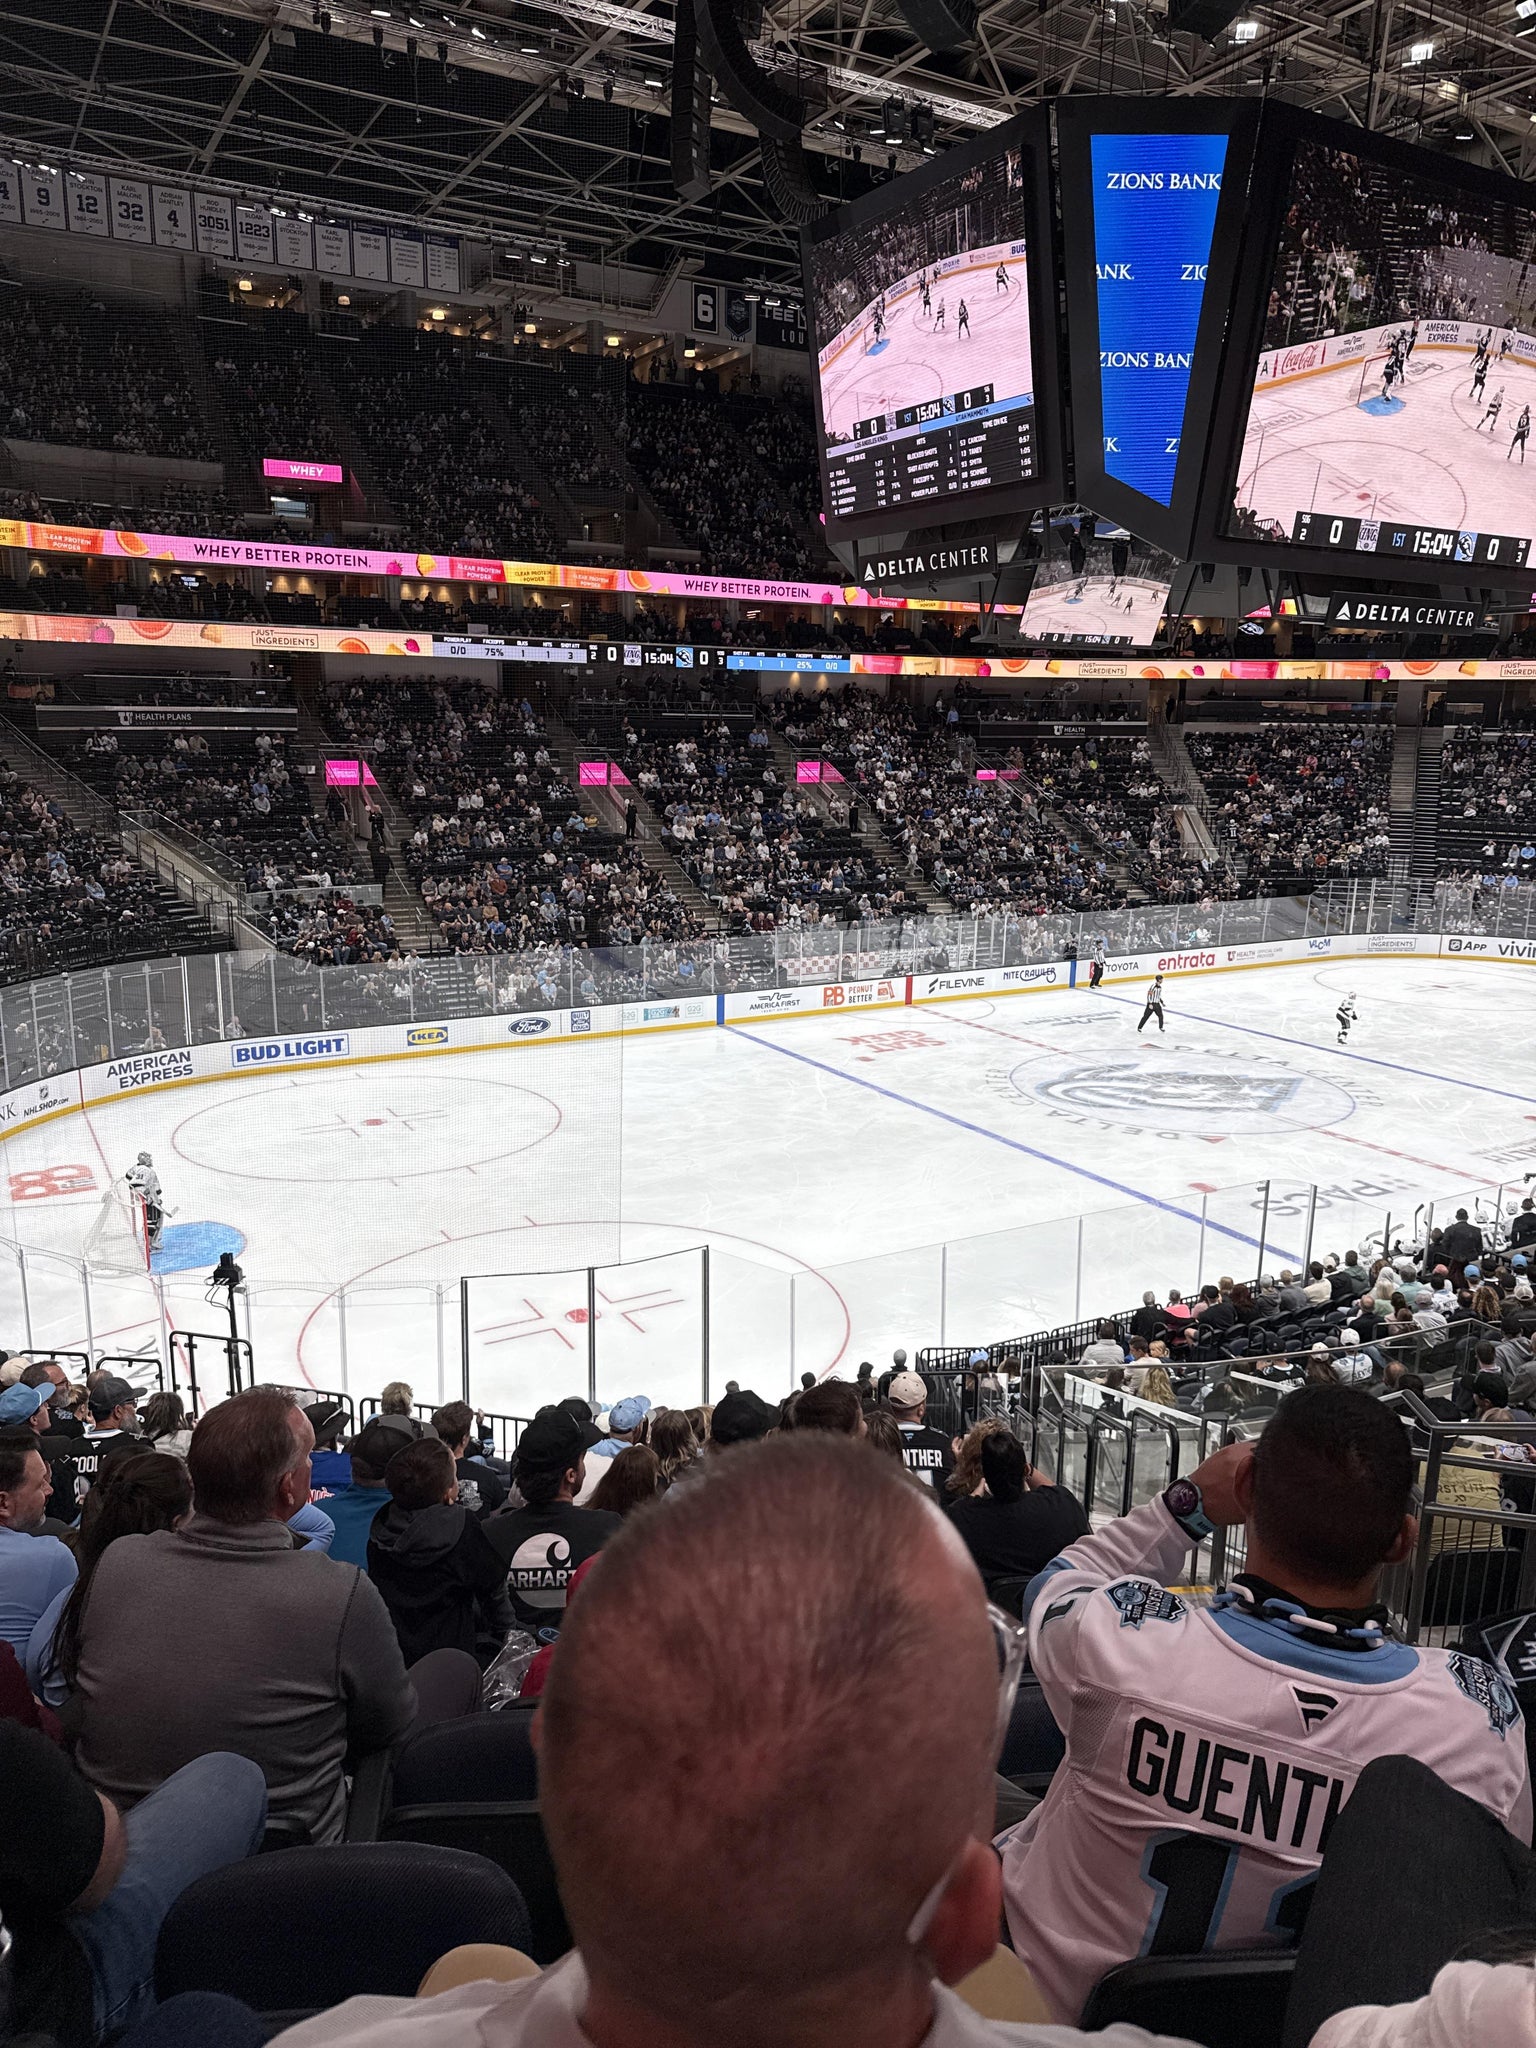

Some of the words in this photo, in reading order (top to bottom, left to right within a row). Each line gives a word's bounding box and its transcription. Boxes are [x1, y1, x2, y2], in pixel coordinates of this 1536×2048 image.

[1107, 173, 1164, 189] ZIONS
[1169, 173, 1221, 190] BANK
[37, 187, 50, 206] 9
[76, 194, 98, 214] 12
[118, 201, 143, 221] 32
[167, 210, 179, 228] 4
[198, 215, 230, 231] 3051
[239, 222, 270, 238] 1223
[697, 294, 713, 323] 6
[1424, 322, 1460, 334] AMERICAN
[1427, 333, 1458, 343] EXPRESS
[1099, 352, 1148, 368] ZIONS
[1154, 353, 1193, 369] BAN
[871, 420, 877, 434] 0
[915, 402, 941, 422] 15:04
[964, 393, 971, 409] 0
[967, 408, 989, 418] MAMMOTH
[982, 421, 993, 429] TIME
[289, 464, 324, 478] WHEY
[64, 536, 91, 545] PROTEIN
[1300, 528, 1306, 541] 2
[1329, 520, 1342, 544] 0
[1392, 532, 1405, 547] 1ST
[1413, 531, 1453, 556] 15:04
[1487, 538, 1499, 561] 0
[53, 541, 81, 550] POWDER
[194, 544, 241, 558] WHEY
[246, 548, 300, 563] BETTER
[306, 553, 371, 568] PROTEIN.
[879, 557, 924, 576] DELTA
[930, 546, 988, 570] CENTER
[1516, 552, 1522, 562] 3
[457, 564, 476, 573] CLEAR
[477, 566, 501, 575] PROTEIN
[467, 572, 492, 580] POWDER
[684, 580, 719, 592] WHEY
[721, 583, 760, 595] BETTER
[764, 586, 811, 598] PROTEIN.
[1354, 603, 1410, 623] DELTA
[1415, 607, 1475, 627] CENTER
[256, 636, 315, 646] INGREDIENTS
[1084, 635, 1101, 643] 15:04
[450, 646, 466, 655] 0/0
[485, 648, 504, 657] 75%
[567, 652, 573, 660] 3
[590, 652, 597, 660] 2
[607, 647, 617, 661] 0
[645, 652, 673, 664] 15:04
[700, 651, 708, 665] 0
[718, 657, 724, 665] 3
[796, 661, 812, 669] 25%
[826, 662, 838, 670] 0/0
[135, 712, 164, 721] HEALTH
[166, 713, 192, 722] PLANS
[1107, 962, 1138, 972] TOYOTA
[1158, 952, 1215, 971] entrata
[848, 984, 873, 994] PEANUT
[939, 977, 985, 990] FILEVINE
[823, 986, 845, 1007] PB
[848, 994, 873, 1003] BETTER
[687, 1005, 702, 1013] G2G
[750, 1002, 780, 1011] AMERICA
[781, 999, 800, 1007] FIRST
[572, 1011, 589, 1019] BUILT
[515, 1020, 543, 1033] Ford
[411, 1031, 445, 1041] IKEA
[832, 1030, 926, 1046] GEEK
[236, 1044, 281, 1062] BUD
[285, 1038, 344, 1057] LIGHT
[873, 1038, 946, 1053] SEAT
[107, 1051, 191, 1078] AMERICAN
[119, 1064, 193, 1089] EXPRESS
[1174, 1046, 1290, 1067] DELTA
[1306, 1069, 1384, 1107] CENTER
[985, 1068, 1035, 1106] CENTER
[1046, 1109, 1180, 1140] DELTA
[902, 1449, 943, 1468] NTHER
[1438, 1484, 1458, 1493] RST
[1463, 1483, 1485, 1492] LITE
[506, 1569, 577, 1589] ARHART
